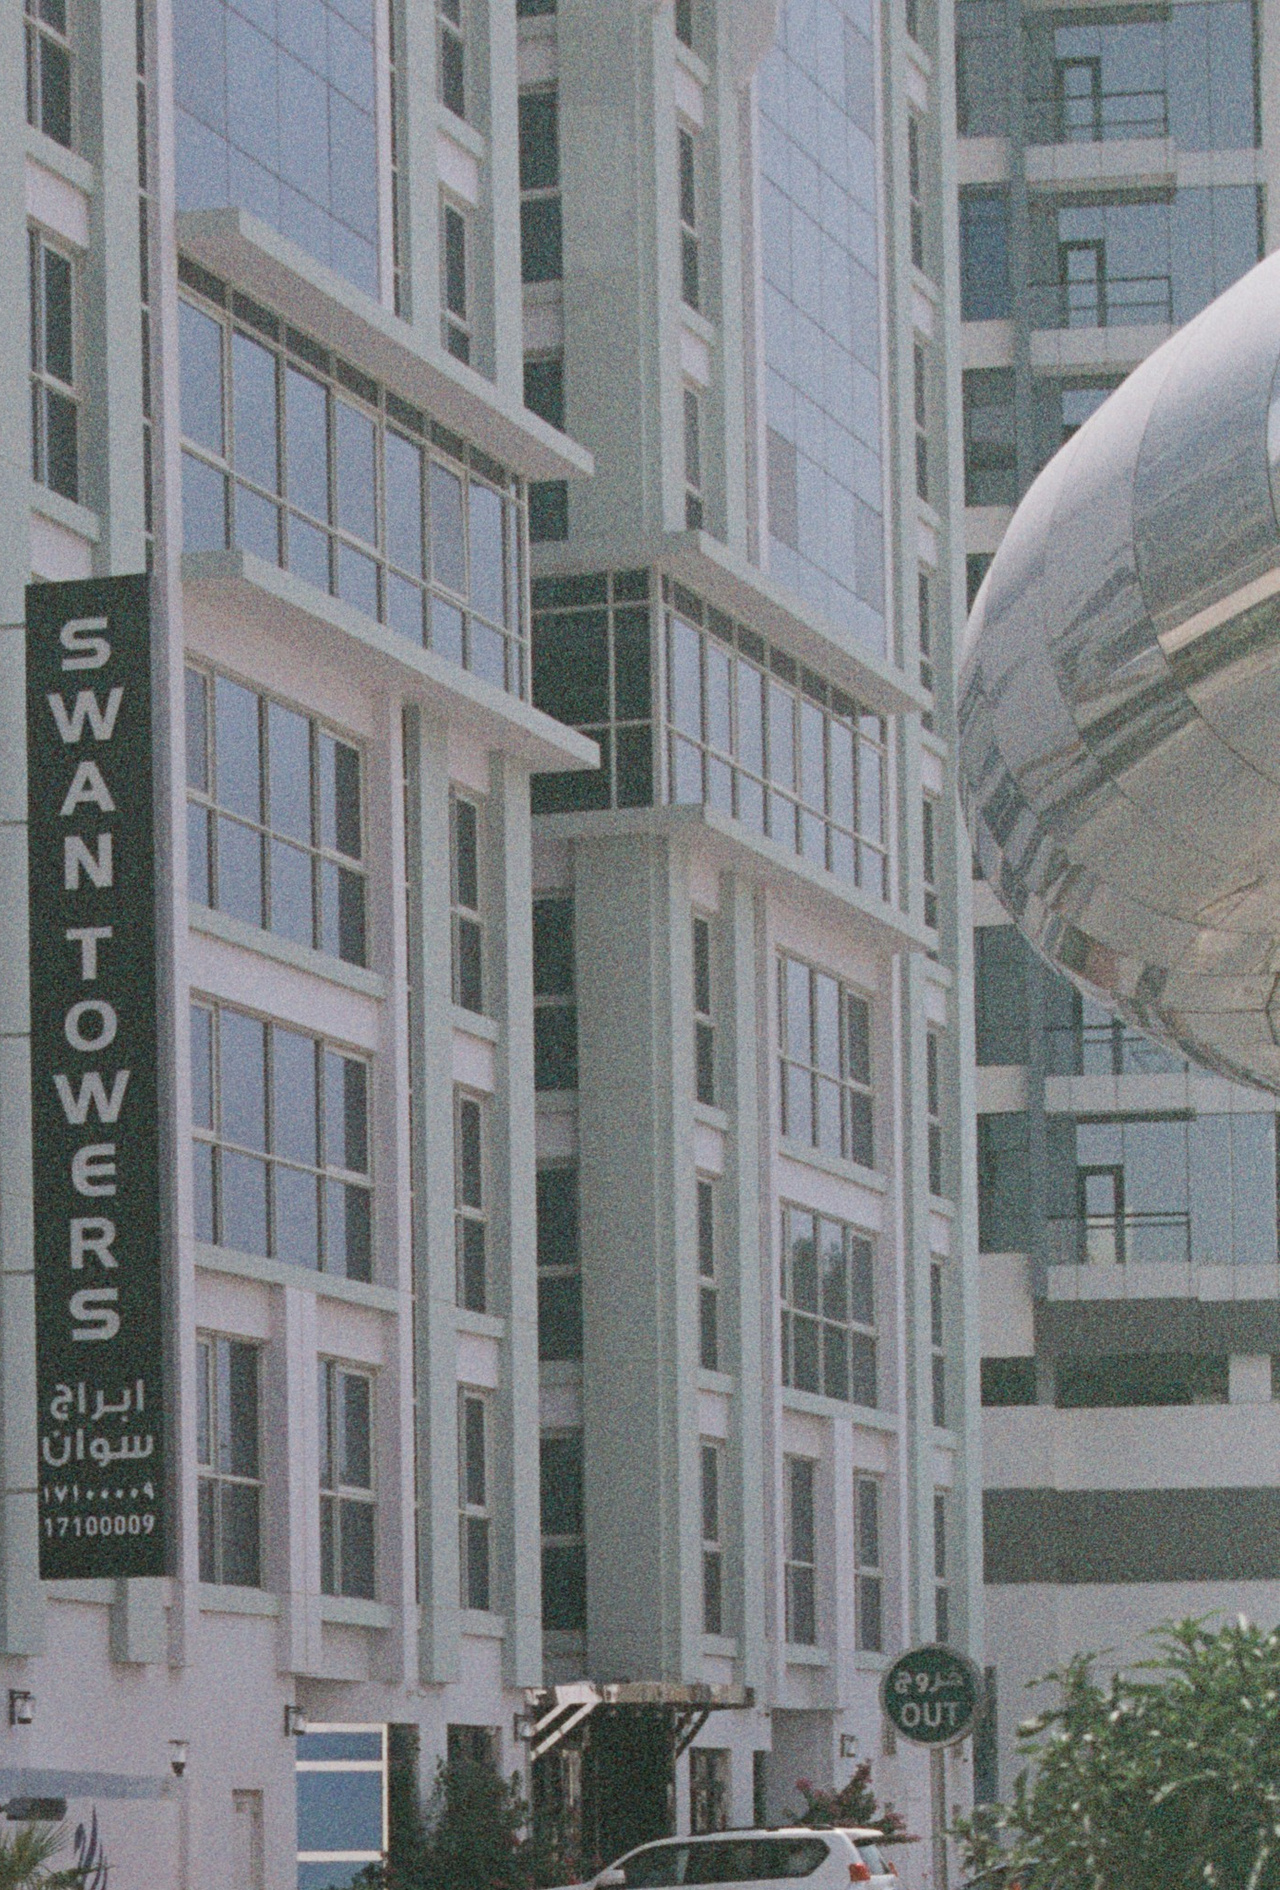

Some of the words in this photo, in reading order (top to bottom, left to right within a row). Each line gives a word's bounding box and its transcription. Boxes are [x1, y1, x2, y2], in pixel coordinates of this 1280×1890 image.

[47, 615, 125, 891] SWAN
[51, 926, 131, 1342] TOWERS
[49, 1379, 145, 1424] ابراج
[41, 1427, 154, 1468] سوان
[43, 1513, 156, 1538] 17100009
[900, 1700, 959, 1728] OUT
